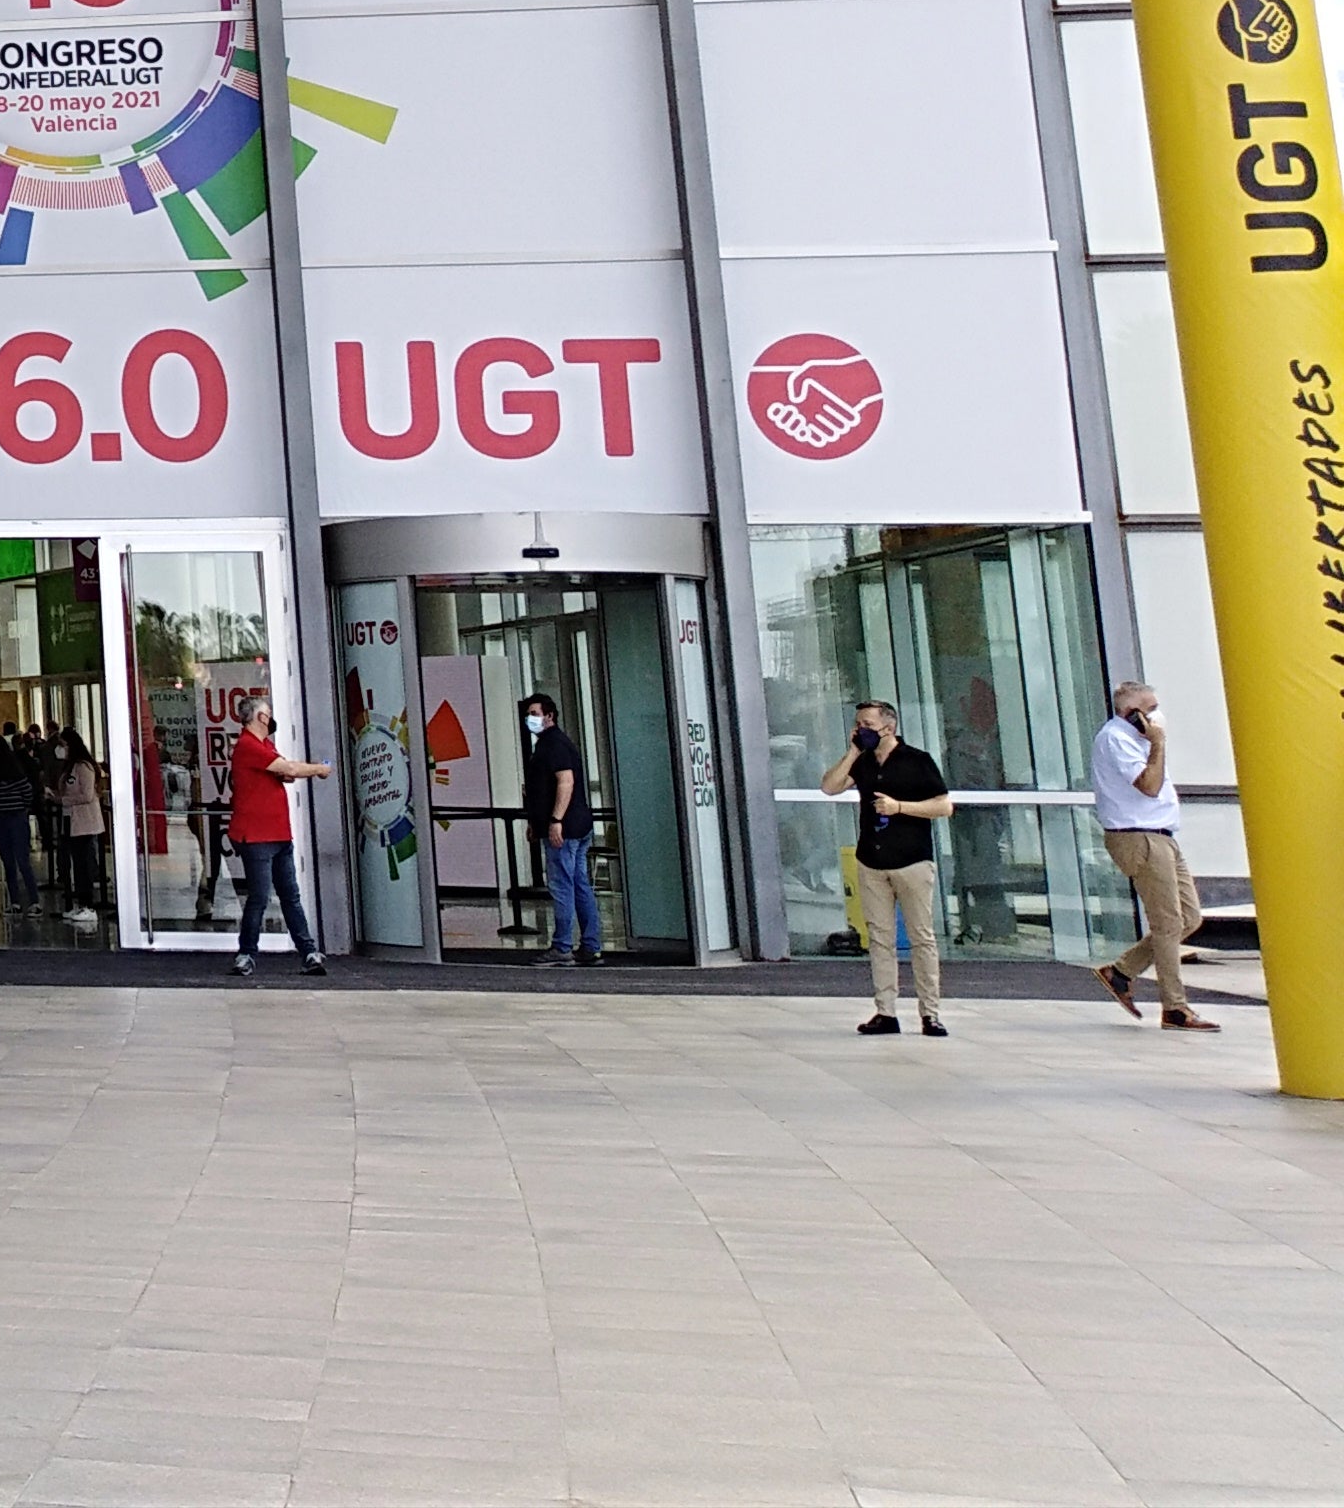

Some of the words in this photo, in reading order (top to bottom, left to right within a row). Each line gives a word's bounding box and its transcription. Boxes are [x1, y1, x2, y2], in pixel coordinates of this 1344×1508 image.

[120, 67, 163, 86] UGT
[49, 96, 106, 113] mayo
[111, 90, 161, 109] 2021
[30, 112, 118, 134] València
[1226, 82, 1329, 273] UGT
[334, 337, 662, 460] UGT
[345, 620, 377, 646] UGT
[687, 723, 706, 742] RED
[210, 733, 240, 761] RE
[689, 746, 703, 765] VO
[386, 765, 394, 777] Y
